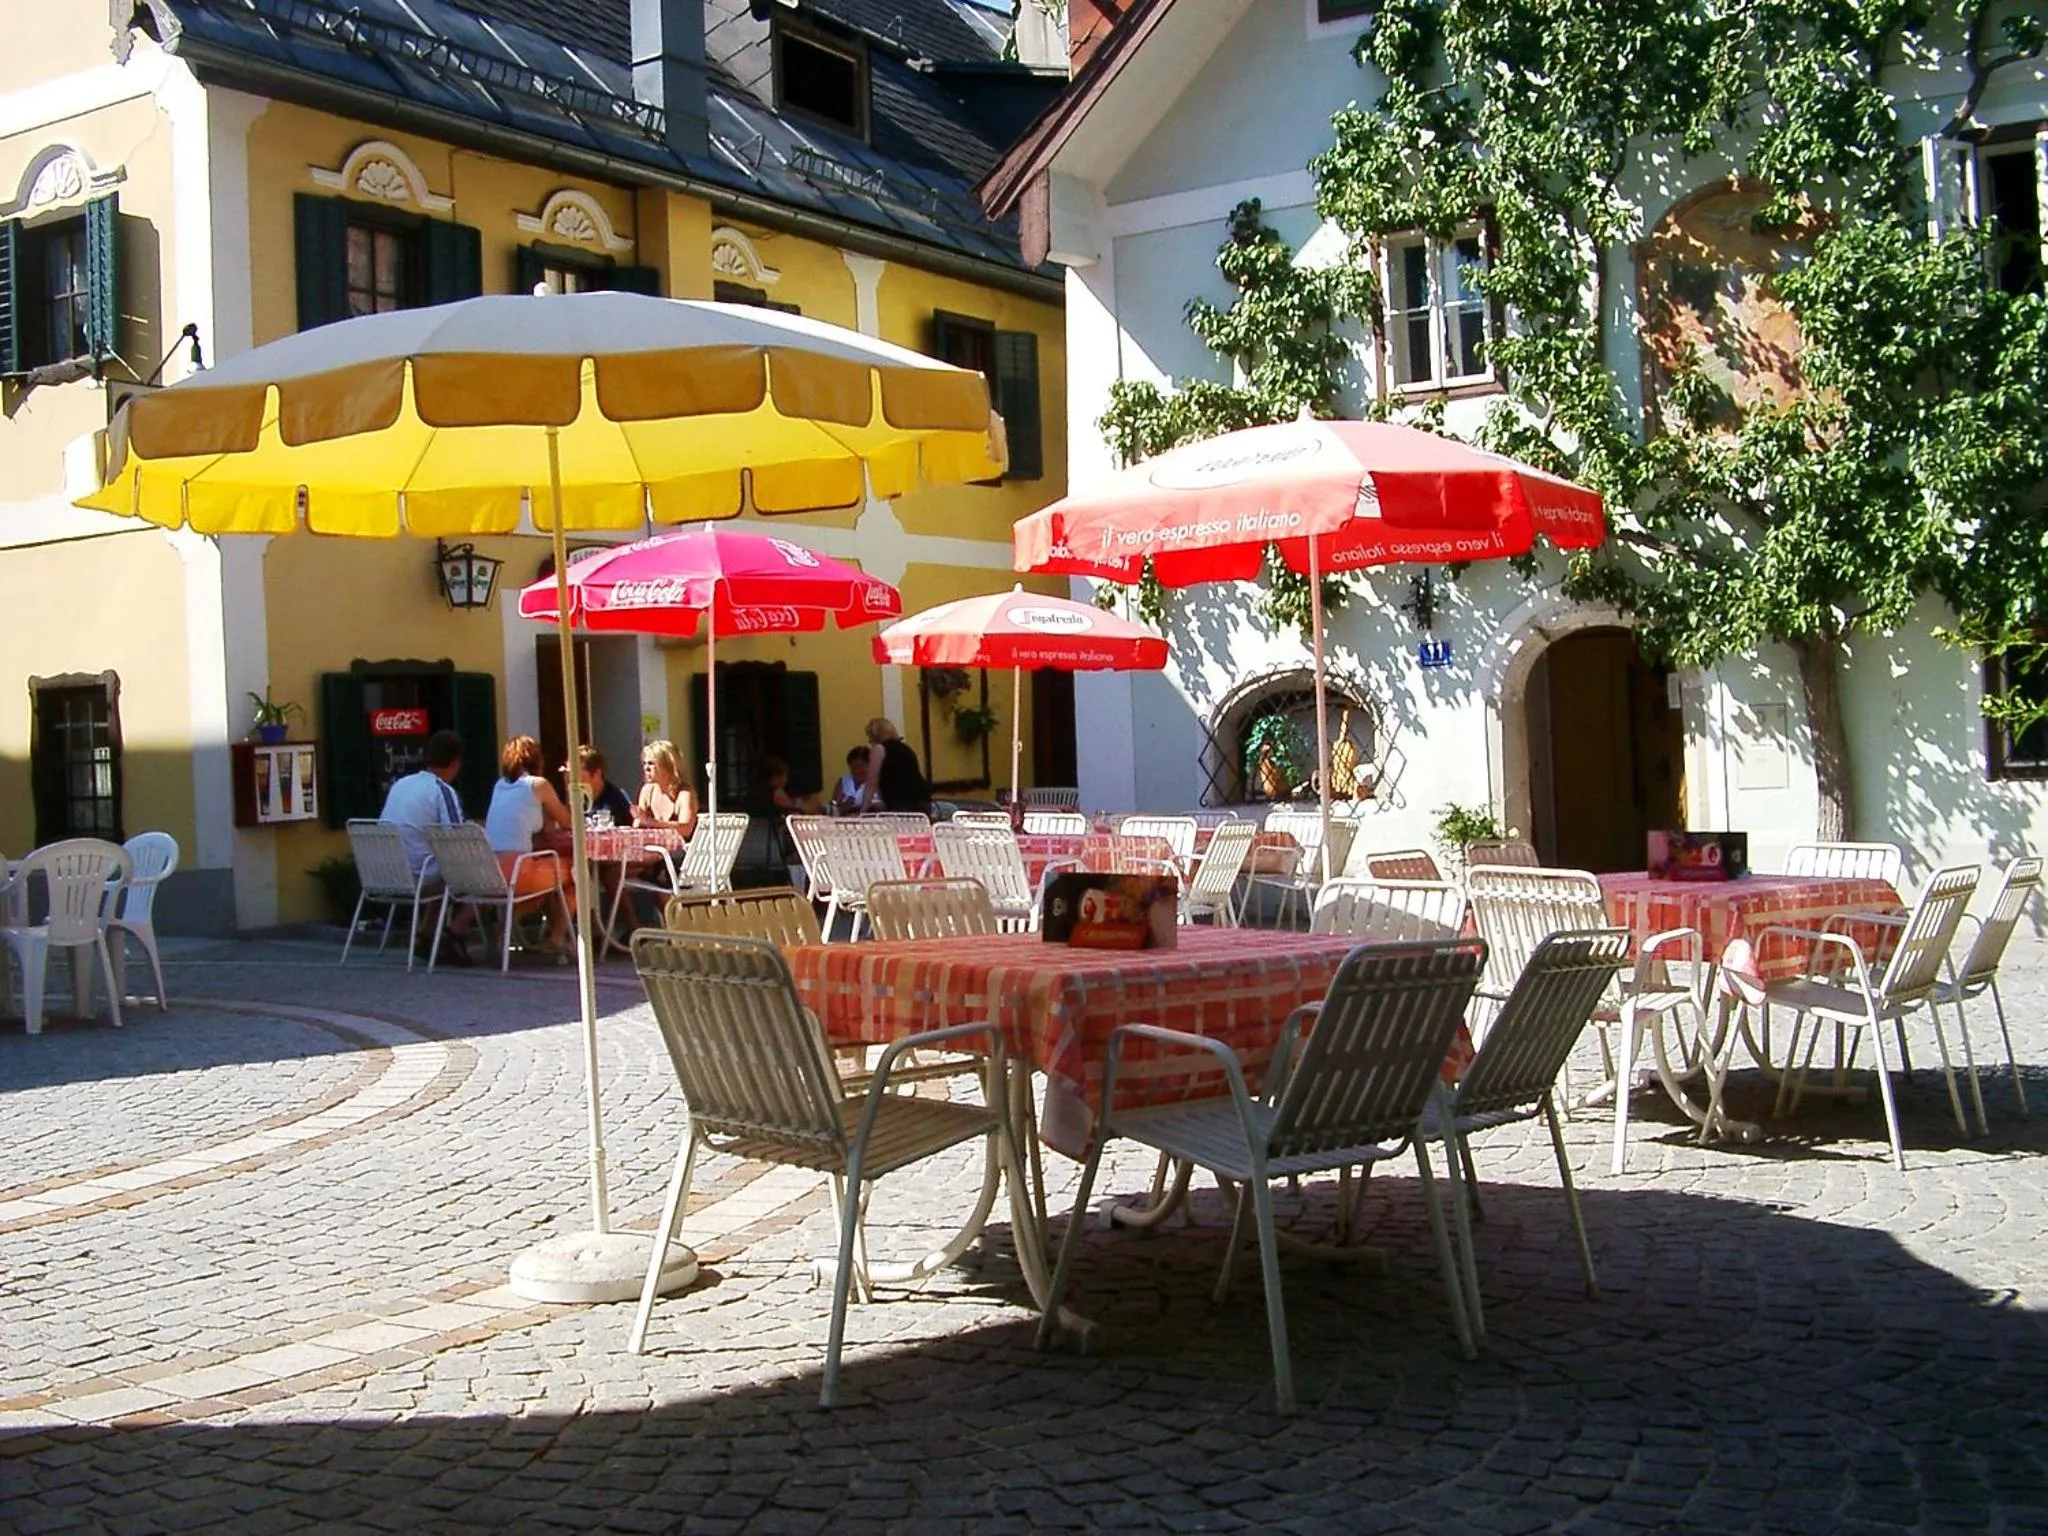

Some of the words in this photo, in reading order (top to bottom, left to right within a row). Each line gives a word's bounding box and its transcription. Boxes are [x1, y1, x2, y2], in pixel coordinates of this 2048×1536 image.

[1101, 526, 1112, 549] il
[1117, 529, 1154, 546] vero
[1157, 518, 1231, 547] espresso
[1235, 508, 1302, 532] italiano
